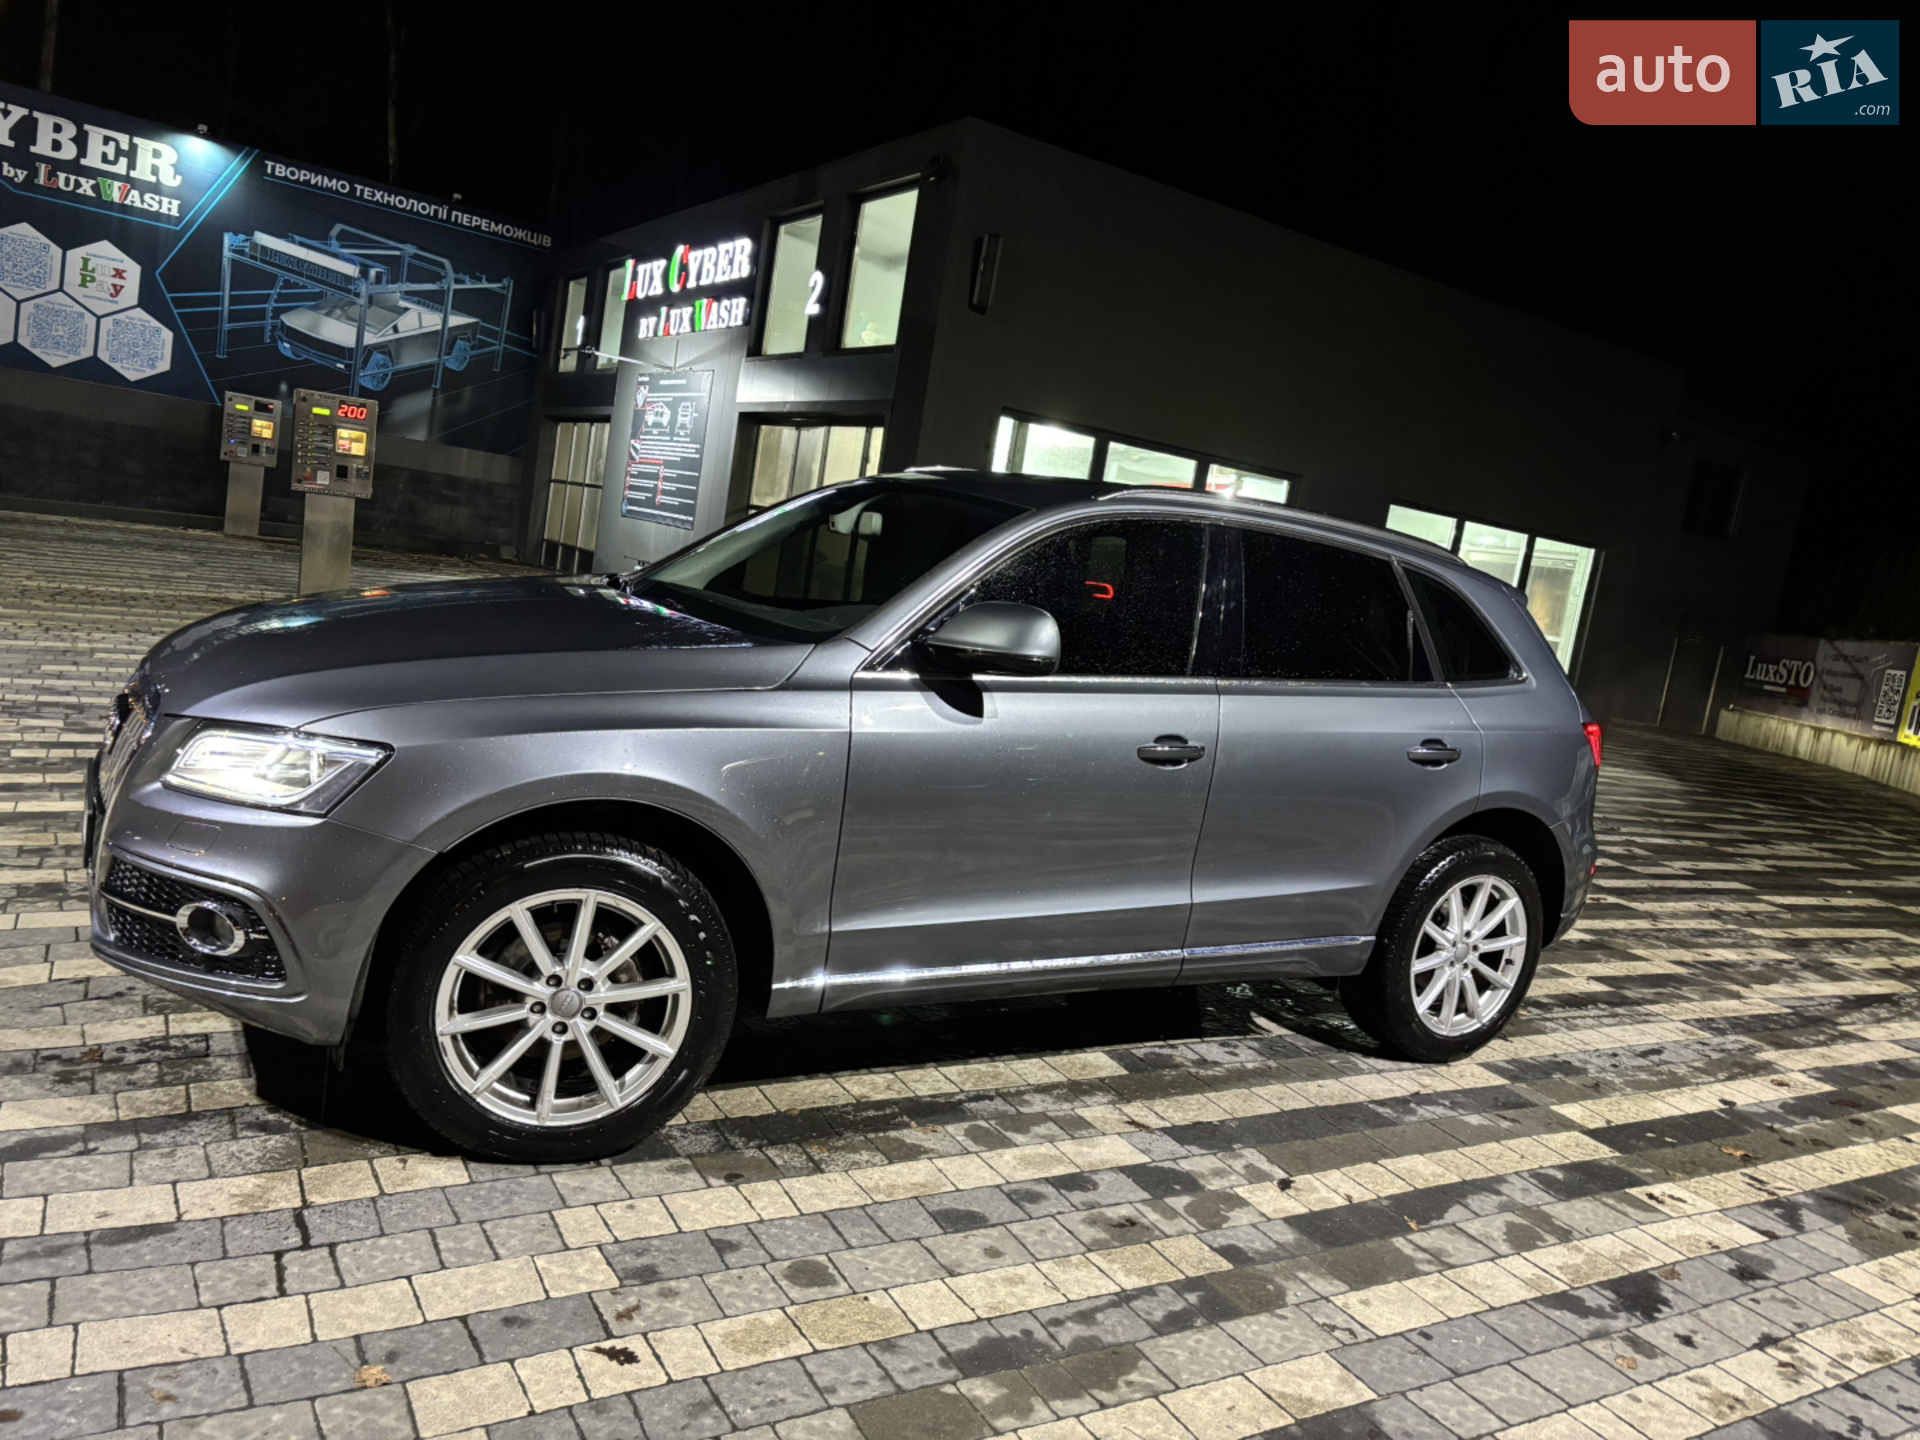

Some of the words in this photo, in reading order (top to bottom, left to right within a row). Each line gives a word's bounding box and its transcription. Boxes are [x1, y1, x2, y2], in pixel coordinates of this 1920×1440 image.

[1, 161, 29, 183] by
[264, 160, 350, 194] ТВОРИМО
[354, 183, 449, 220] ТЕХНОЛОГІЇ
[451, 210, 552, 248] ПЕРЕМОЖЦІВ
[668, 237, 752, 292] CYBER
[804, 269, 825, 316] 2
[337, 404, 368, 421] 200
[1744, 655, 1815, 688] LuxSTO
